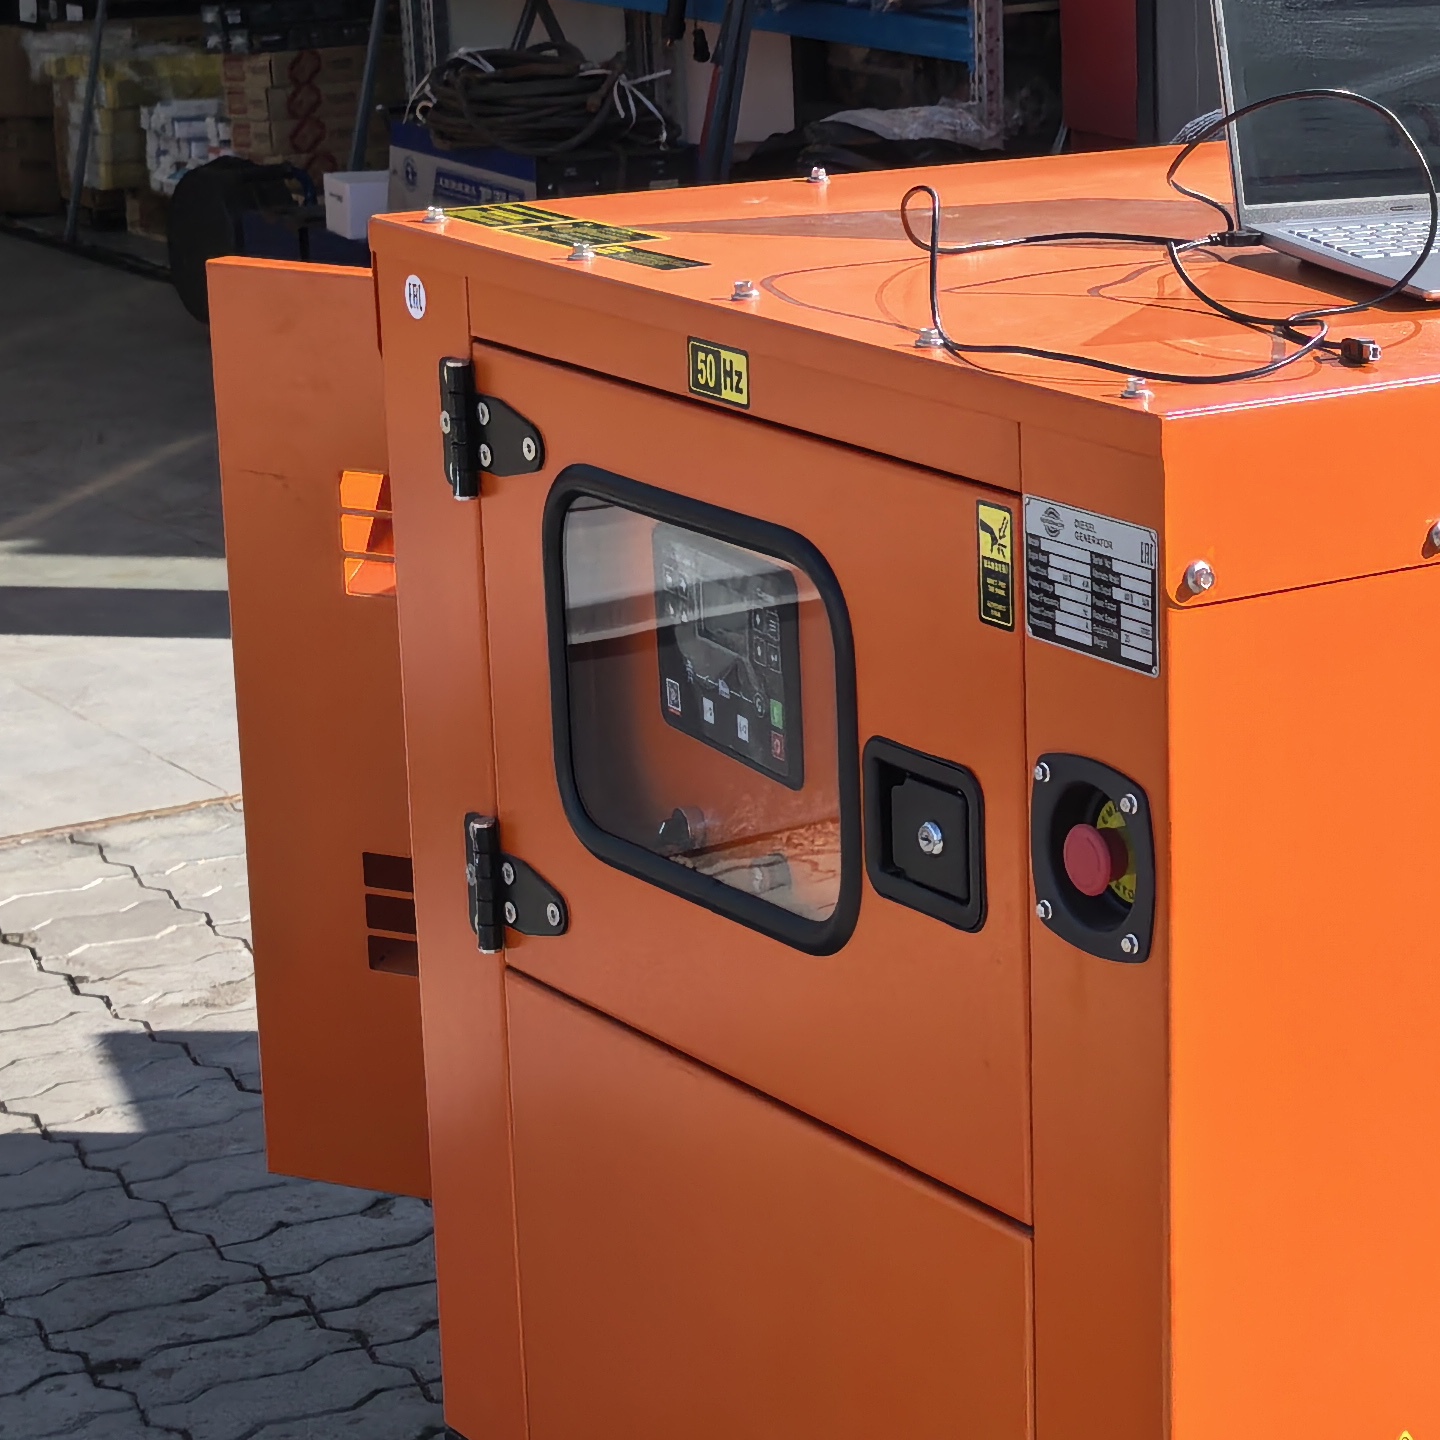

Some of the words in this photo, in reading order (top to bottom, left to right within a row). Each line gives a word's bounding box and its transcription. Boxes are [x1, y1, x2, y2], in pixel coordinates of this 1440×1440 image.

[697, 351, 716, 387] 50
[722, 357, 743, 395] Hz
[1073, 518, 1097, 534] DIESEL
[1074, 531, 1113, 550] GENERATOR
